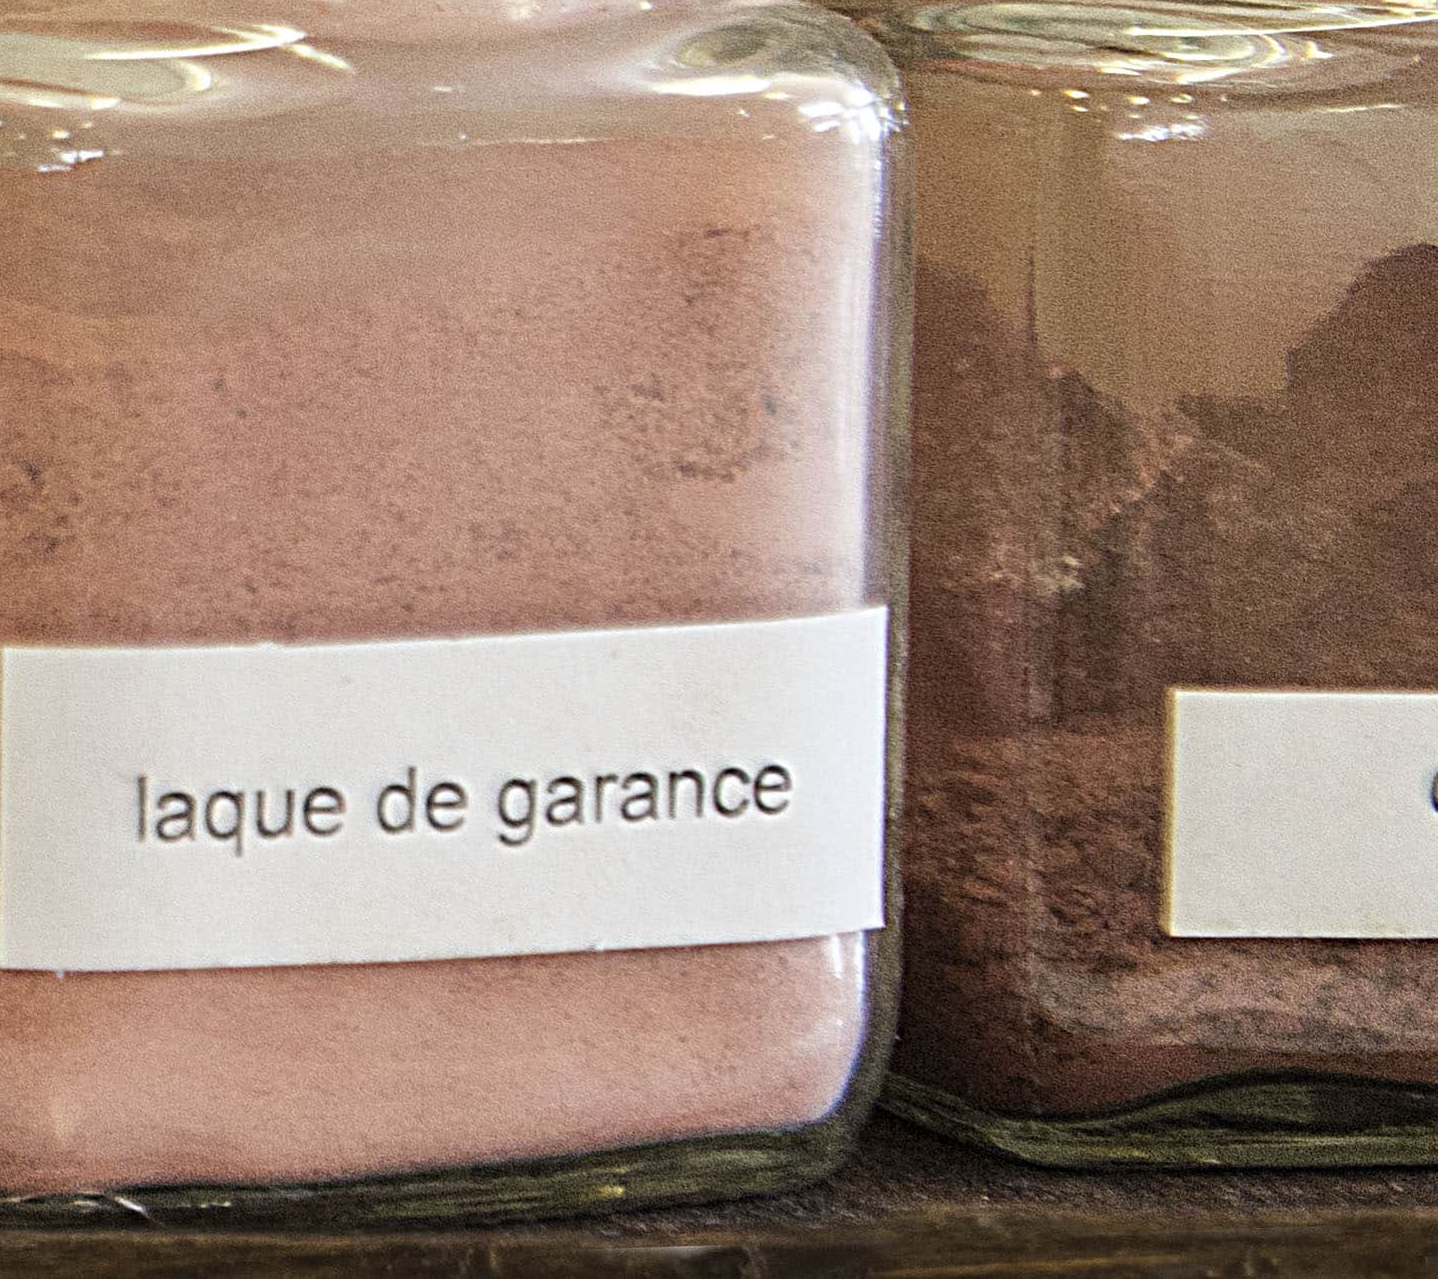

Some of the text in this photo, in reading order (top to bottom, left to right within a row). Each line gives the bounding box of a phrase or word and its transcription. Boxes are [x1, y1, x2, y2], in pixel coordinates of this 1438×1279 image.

[136, 761, 794, 857] laque de garance
